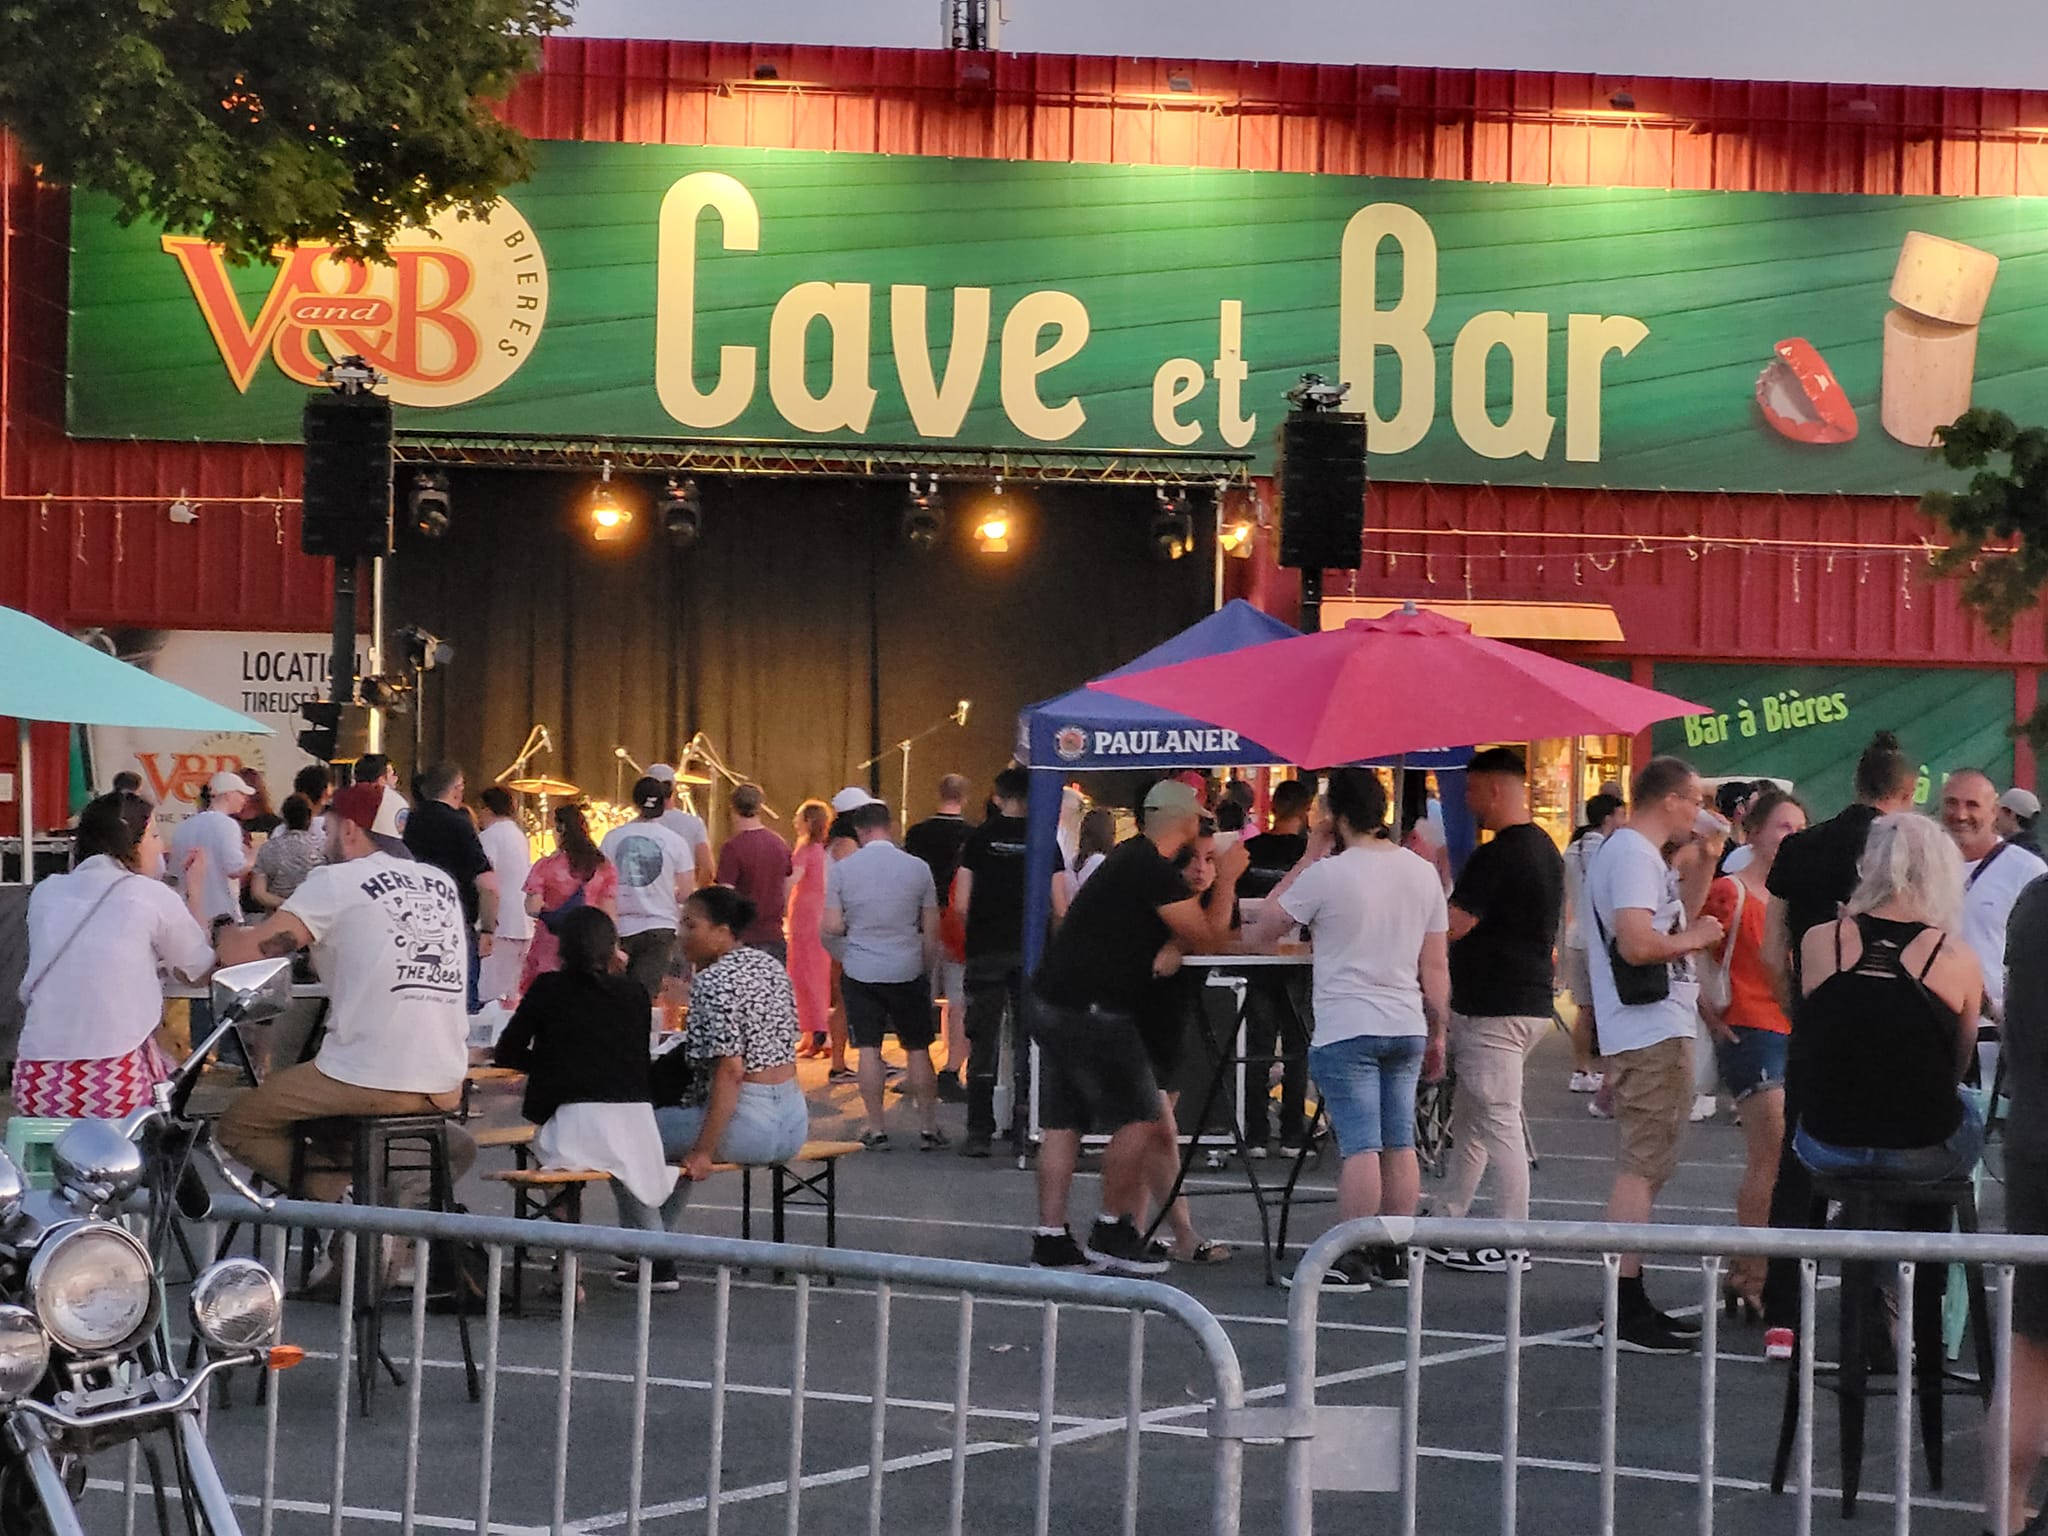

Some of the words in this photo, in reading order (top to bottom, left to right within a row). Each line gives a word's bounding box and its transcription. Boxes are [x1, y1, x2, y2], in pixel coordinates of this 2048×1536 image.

[296, 302, 380, 321] and
[656, 172, 1090, 441] Cave
[1152, 300, 1256, 449] et
[1340, 202, 1651, 463] Bar
[1684, 714, 1730, 747] Bar
[1738, 698, 1757, 737] à
[1762, 689, 1849, 732] Bières
[1093, 729, 1240, 755] PAULANER
[360, 870, 418, 901] HERE
[421, 876, 457, 908] FOR
[396, 965, 426, 980] THE
